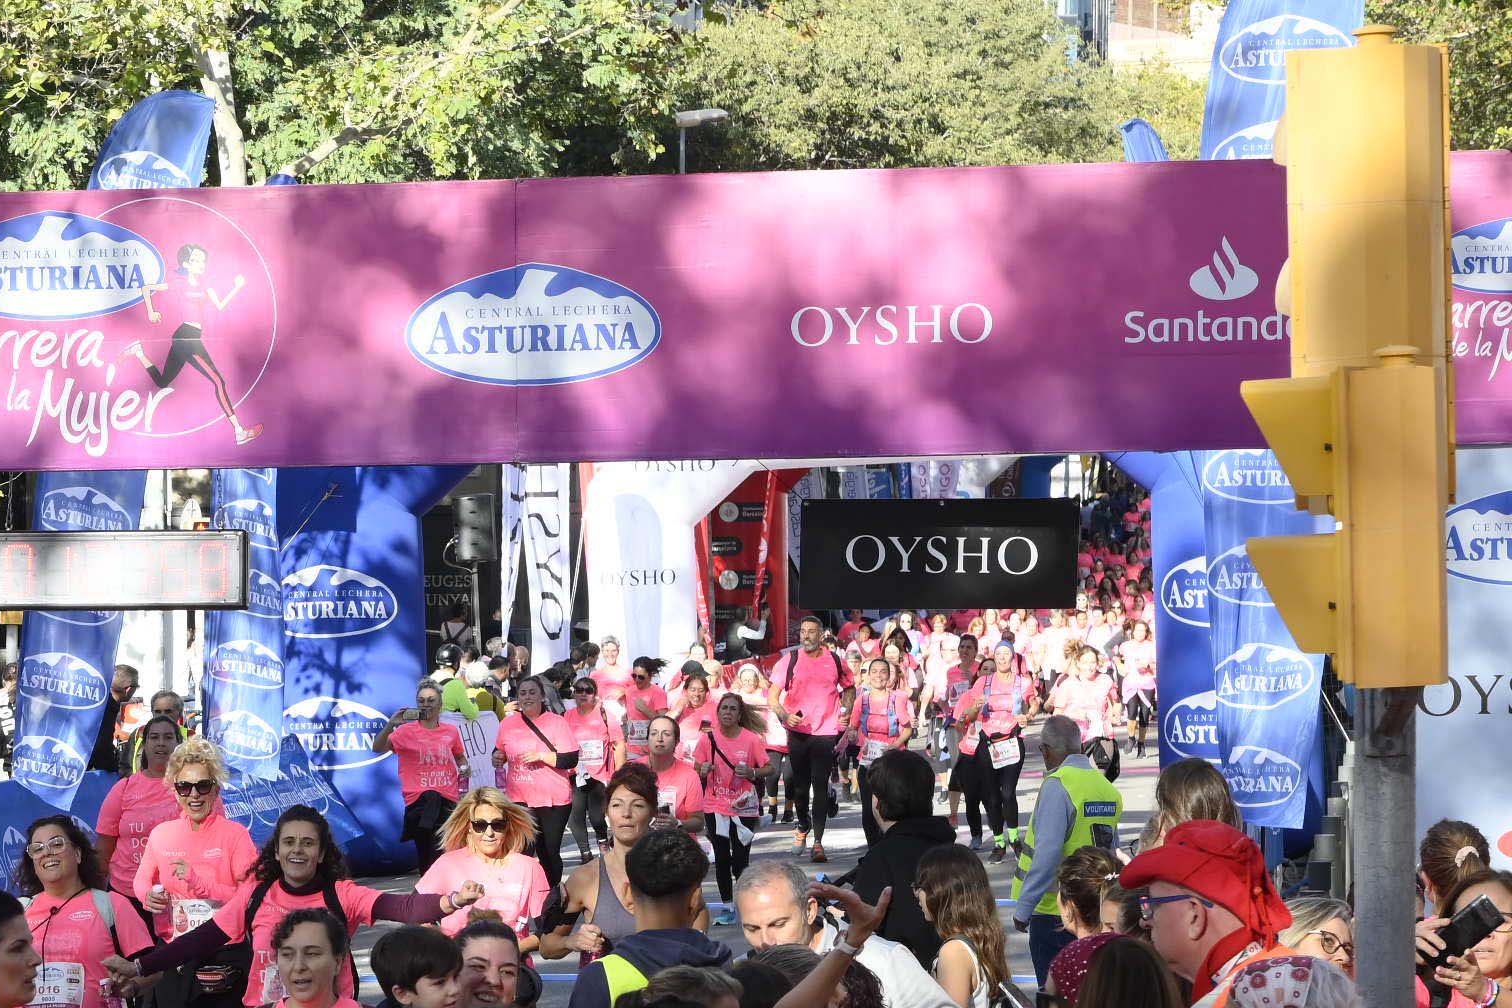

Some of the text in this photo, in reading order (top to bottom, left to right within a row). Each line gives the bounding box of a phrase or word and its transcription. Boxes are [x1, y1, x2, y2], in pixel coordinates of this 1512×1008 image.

[67, 247, 141, 259] LECHERA
[464, 304, 633, 320] CENTRAL LECHERA
[790, 302, 993, 347] OYSHO
[426, 311, 641, 355] ASTURIANA
[1475, 329, 1492, 357] la
[6, 369, 31, 413] la
[25, 365, 176, 458] Mujer
[845, 533, 1040, 577] OYSHO
[600, 568, 677, 588] OYSHO
[284, 600, 389, 622] STURIANA
[22, 666, 100, 702] ASTURIANA
[129, 823, 144, 833] TU
[39, 985, 60, 994] 016
